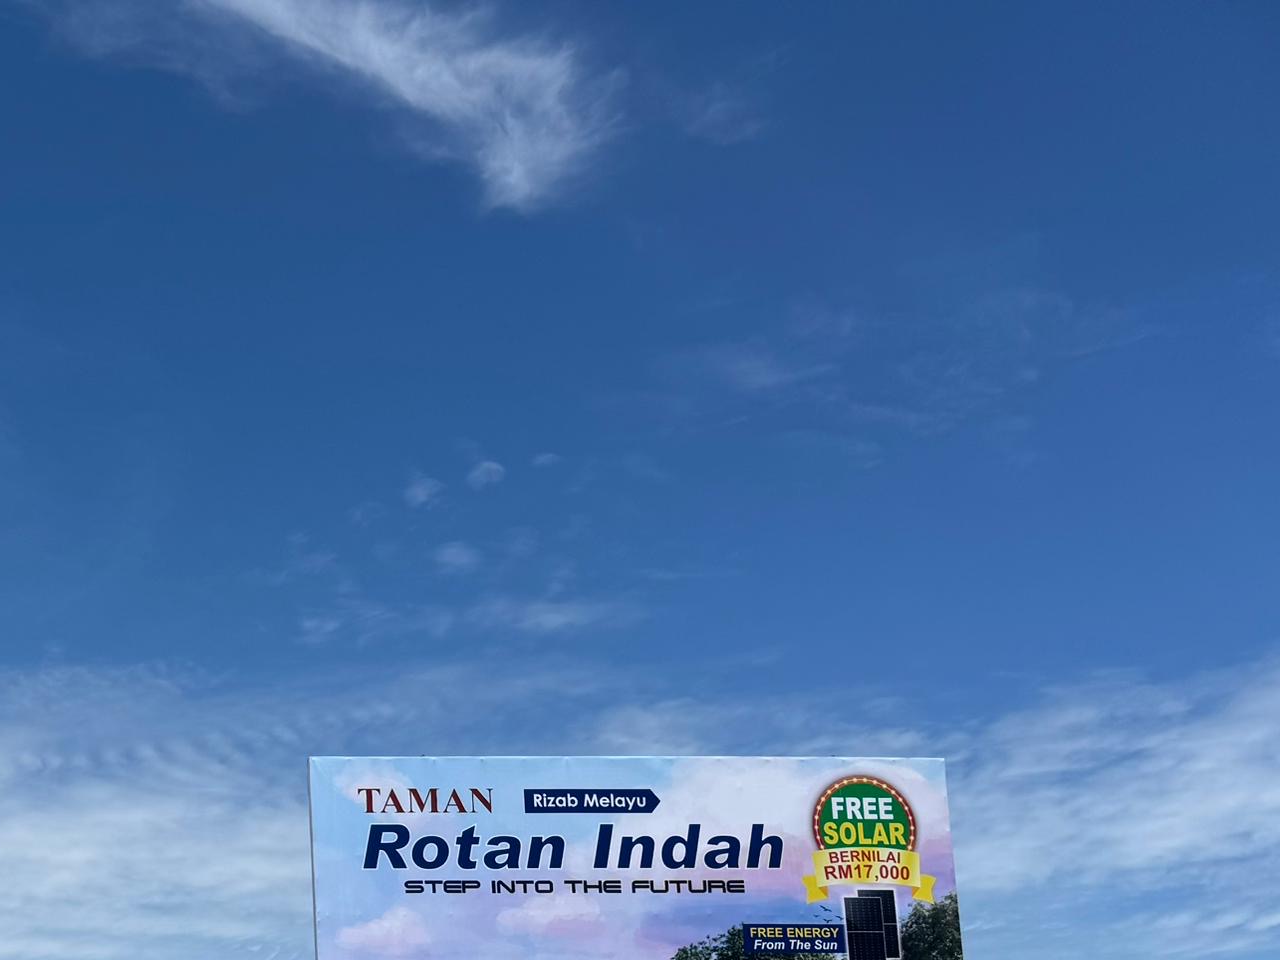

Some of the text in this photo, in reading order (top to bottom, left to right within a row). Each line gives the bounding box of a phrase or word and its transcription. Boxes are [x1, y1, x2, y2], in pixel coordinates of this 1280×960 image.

[358, 788, 493, 814] TAMAN
[533, 793, 647, 810] Rizab Melayu
[830, 796, 894, 820] FREE
[823, 822, 906, 846] SOLAR
[363, 823, 784, 870] Rotan Indah
[828, 850, 901, 864] BERNILAI
[824, 864, 910, 881] RM17,000
[404, 879, 746, 894] STEP INTO THE FUTURE
[750, 927, 839, 938] FREE ENERGY
[754, 939, 838, 950] From The Sun
